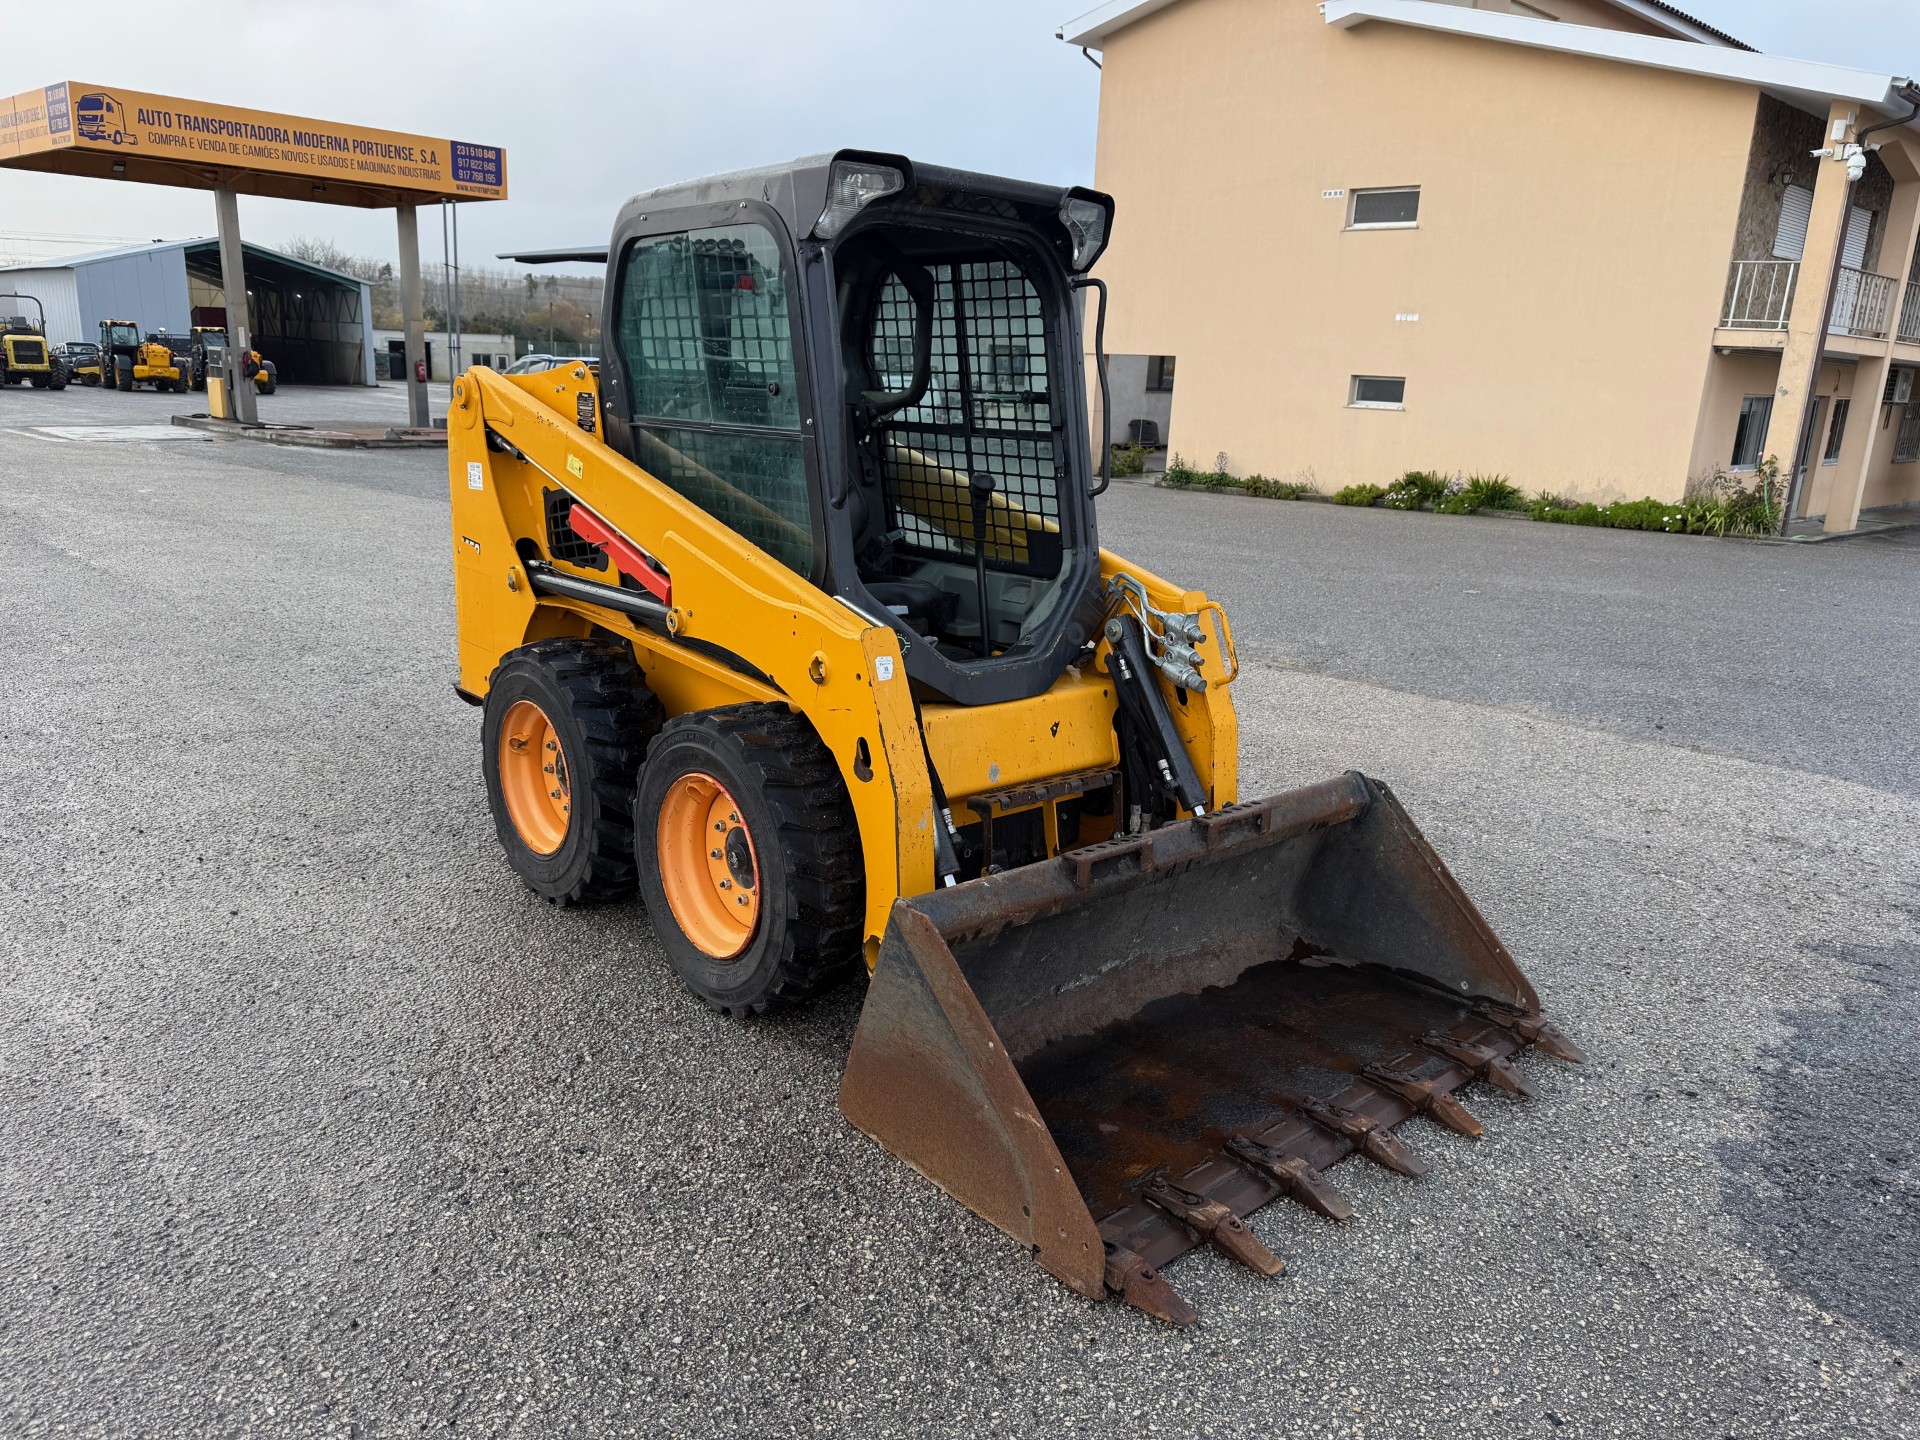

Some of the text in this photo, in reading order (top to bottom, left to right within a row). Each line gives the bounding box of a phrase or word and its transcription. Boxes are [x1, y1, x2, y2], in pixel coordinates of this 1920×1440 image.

[137, 107, 440, 166] AUTO TRANSPORTADORA MODERNA PORTUENSE, S.A.
[148, 131, 441, 181] COMPRA E VENDA DE CAMIÕES NOVOS E USADOS E MÁQUINAS INDUSTRIAIS
[456, 145, 496, 160] 231 510 840
[457, 157, 470, 168] 917
[470, 159, 483, 170] 822
[458, 169, 470, 180] 917
